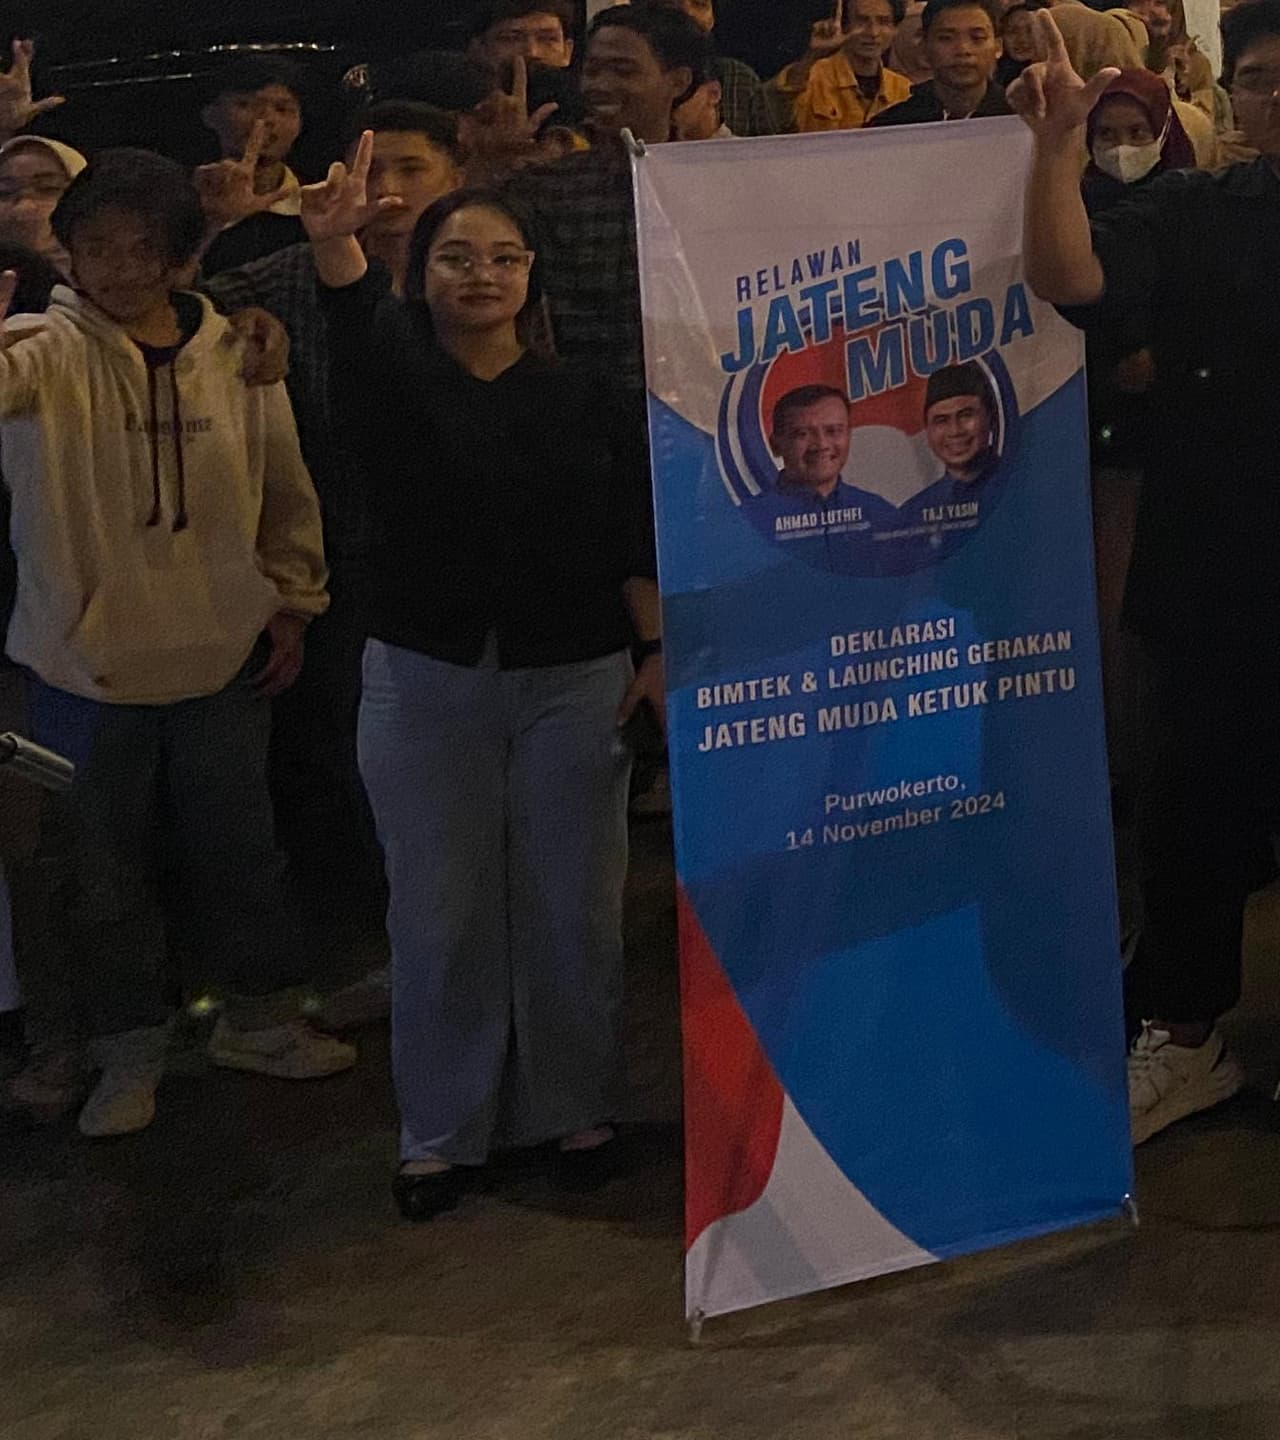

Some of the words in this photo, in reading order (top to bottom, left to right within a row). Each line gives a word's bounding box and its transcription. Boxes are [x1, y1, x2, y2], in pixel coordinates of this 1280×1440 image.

[736, 239, 862, 302] RELAWAN
[720, 237, 972, 374] JATENG
[846, 282, 1034, 402] MUDA
[775, 515, 817, 532] AHMAD
[821, 507, 863, 526] LUTHFI
[922, 508, 943, 522] TAJ
[948, 502, 979, 520] YASIN
[831, 617, 955, 657] DEKLARASI
[697, 674, 792, 709] BIMTEK
[801, 671, 818, 694] &
[828, 647, 959, 689] LAUNCHING
[968, 630, 1072, 665] GERAKAN
[698, 713, 806, 752] JATENG
[818, 697, 898, 733] MUDA
[908, 680, 989, 717] KETUK
[998, 667, 1076, 701] PINTU
[786, 828, 813, 851] 14
[823, 807, 941, 844] November
[951, 791, 1005, 820] 2024
[825, 773, 966, 814] Purwokerto,
